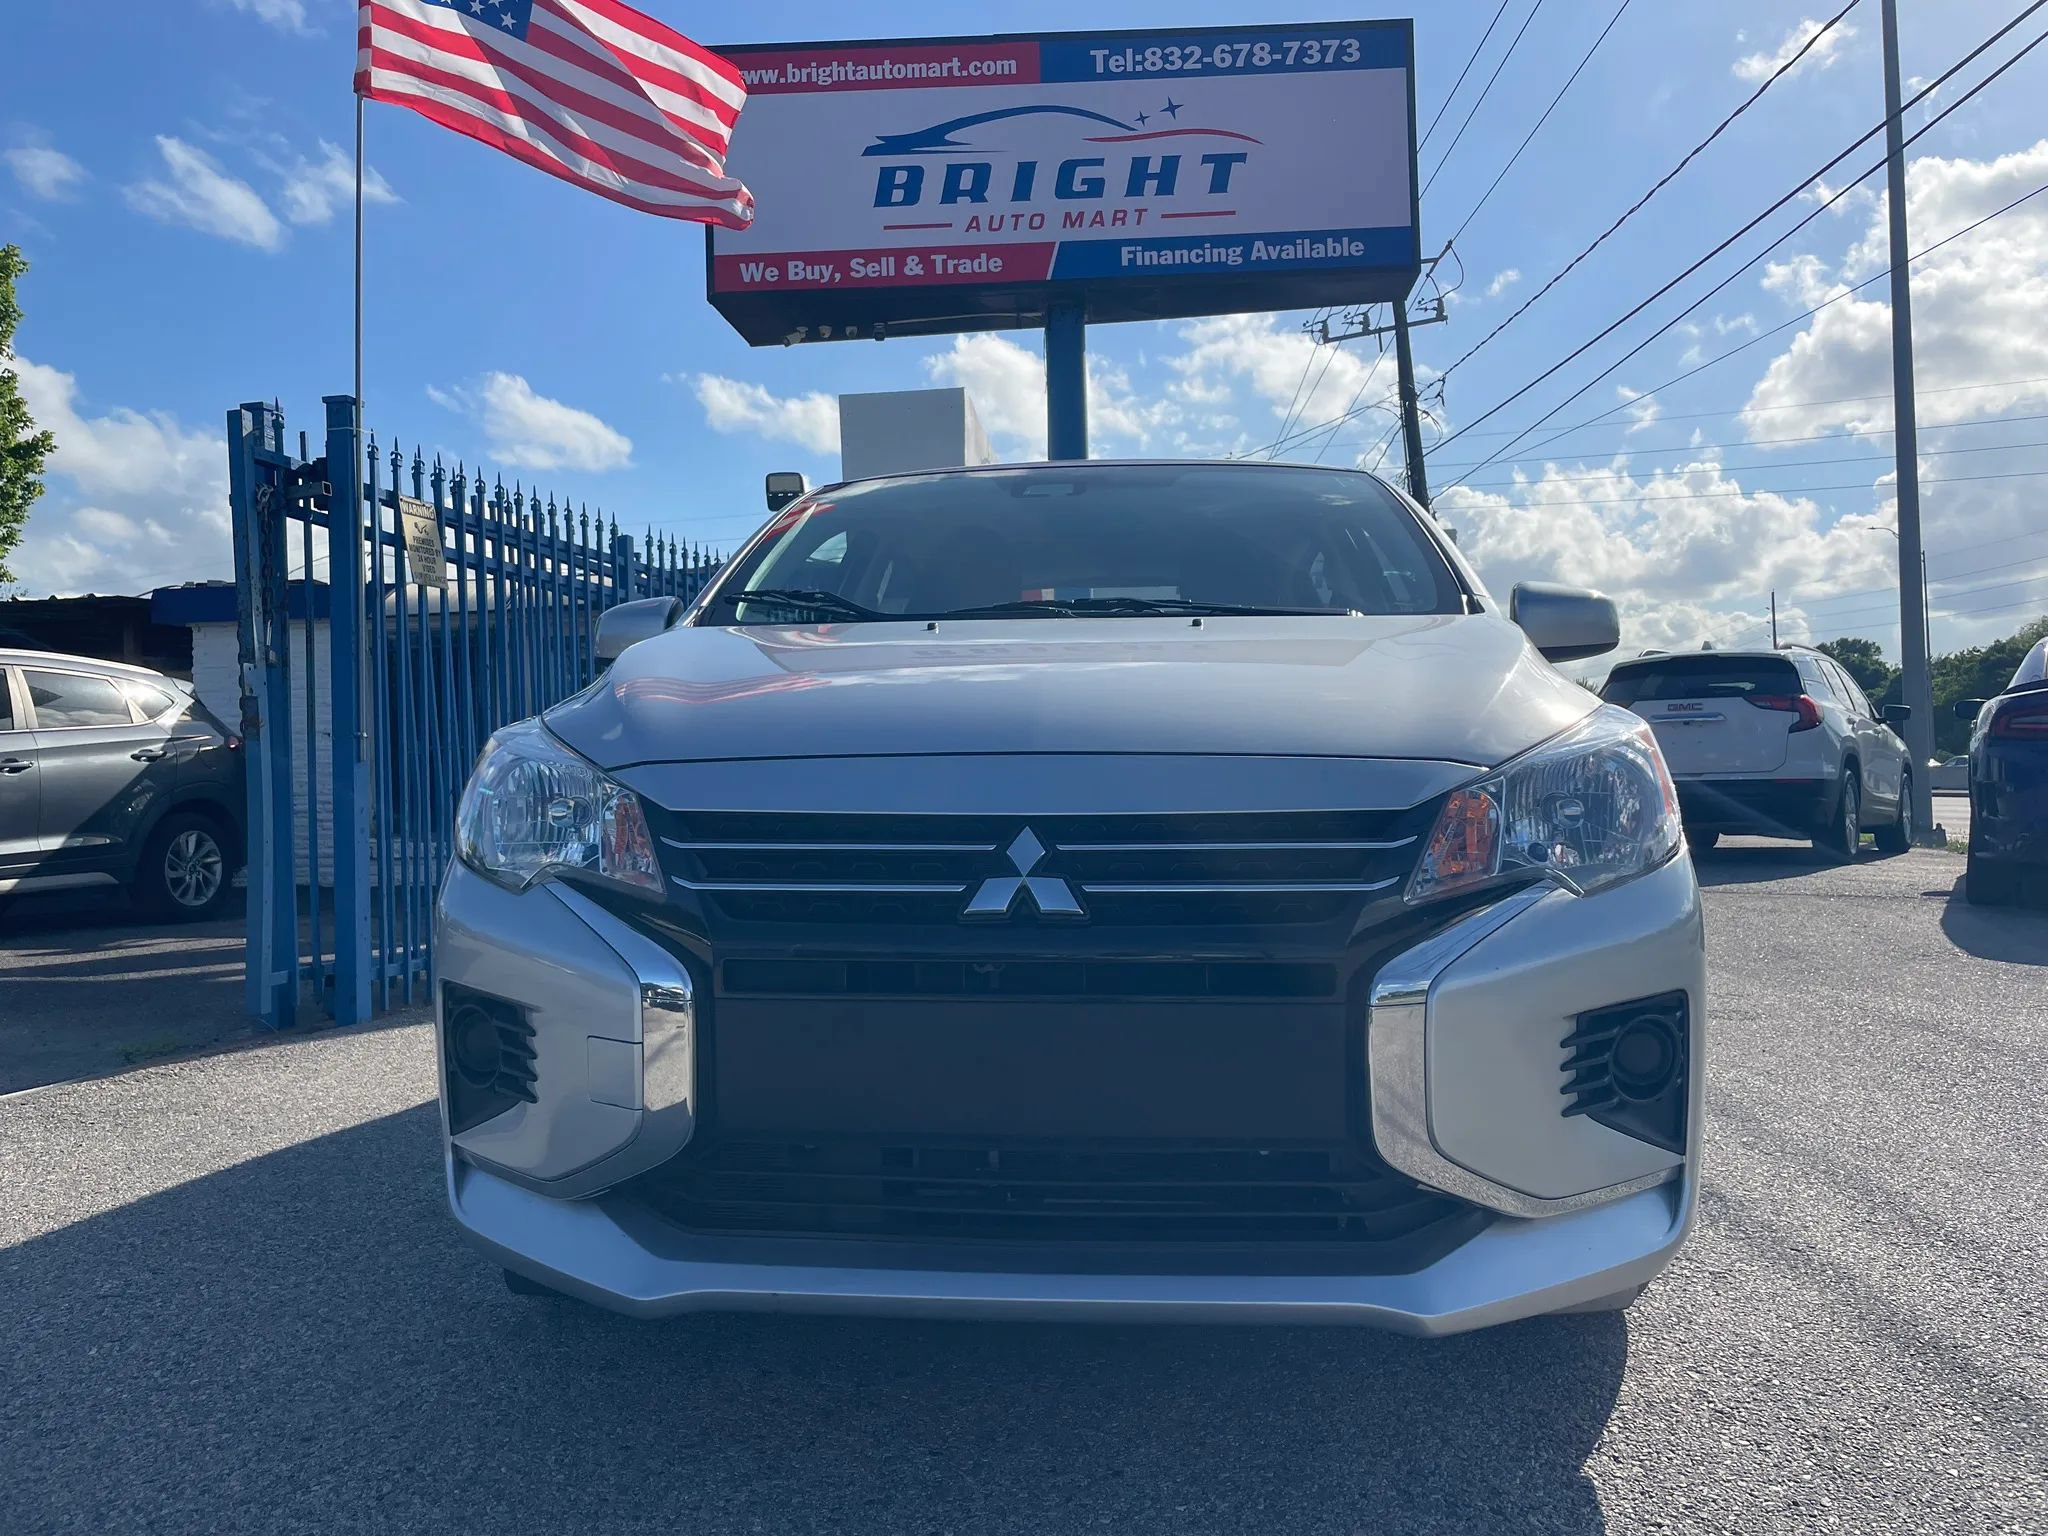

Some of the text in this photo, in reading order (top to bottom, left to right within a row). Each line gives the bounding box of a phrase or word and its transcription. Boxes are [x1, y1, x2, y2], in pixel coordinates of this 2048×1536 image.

[1090, 39, 1361, 74] Tel:832-678-7373
[740, 57, 1017, 86] ww.brightautomart.com
[873, 152, 1248, 208] BRIGHT
[965, 208, 1149, 233] AUTO MART
[1121, 237, 1365, 266] Financing Available
[739, 253, 1003, 284] We Buy, Sell & Trade
[401, 501, 435, 519] WARNING
[1667, 702, 1704, 712] GMC
